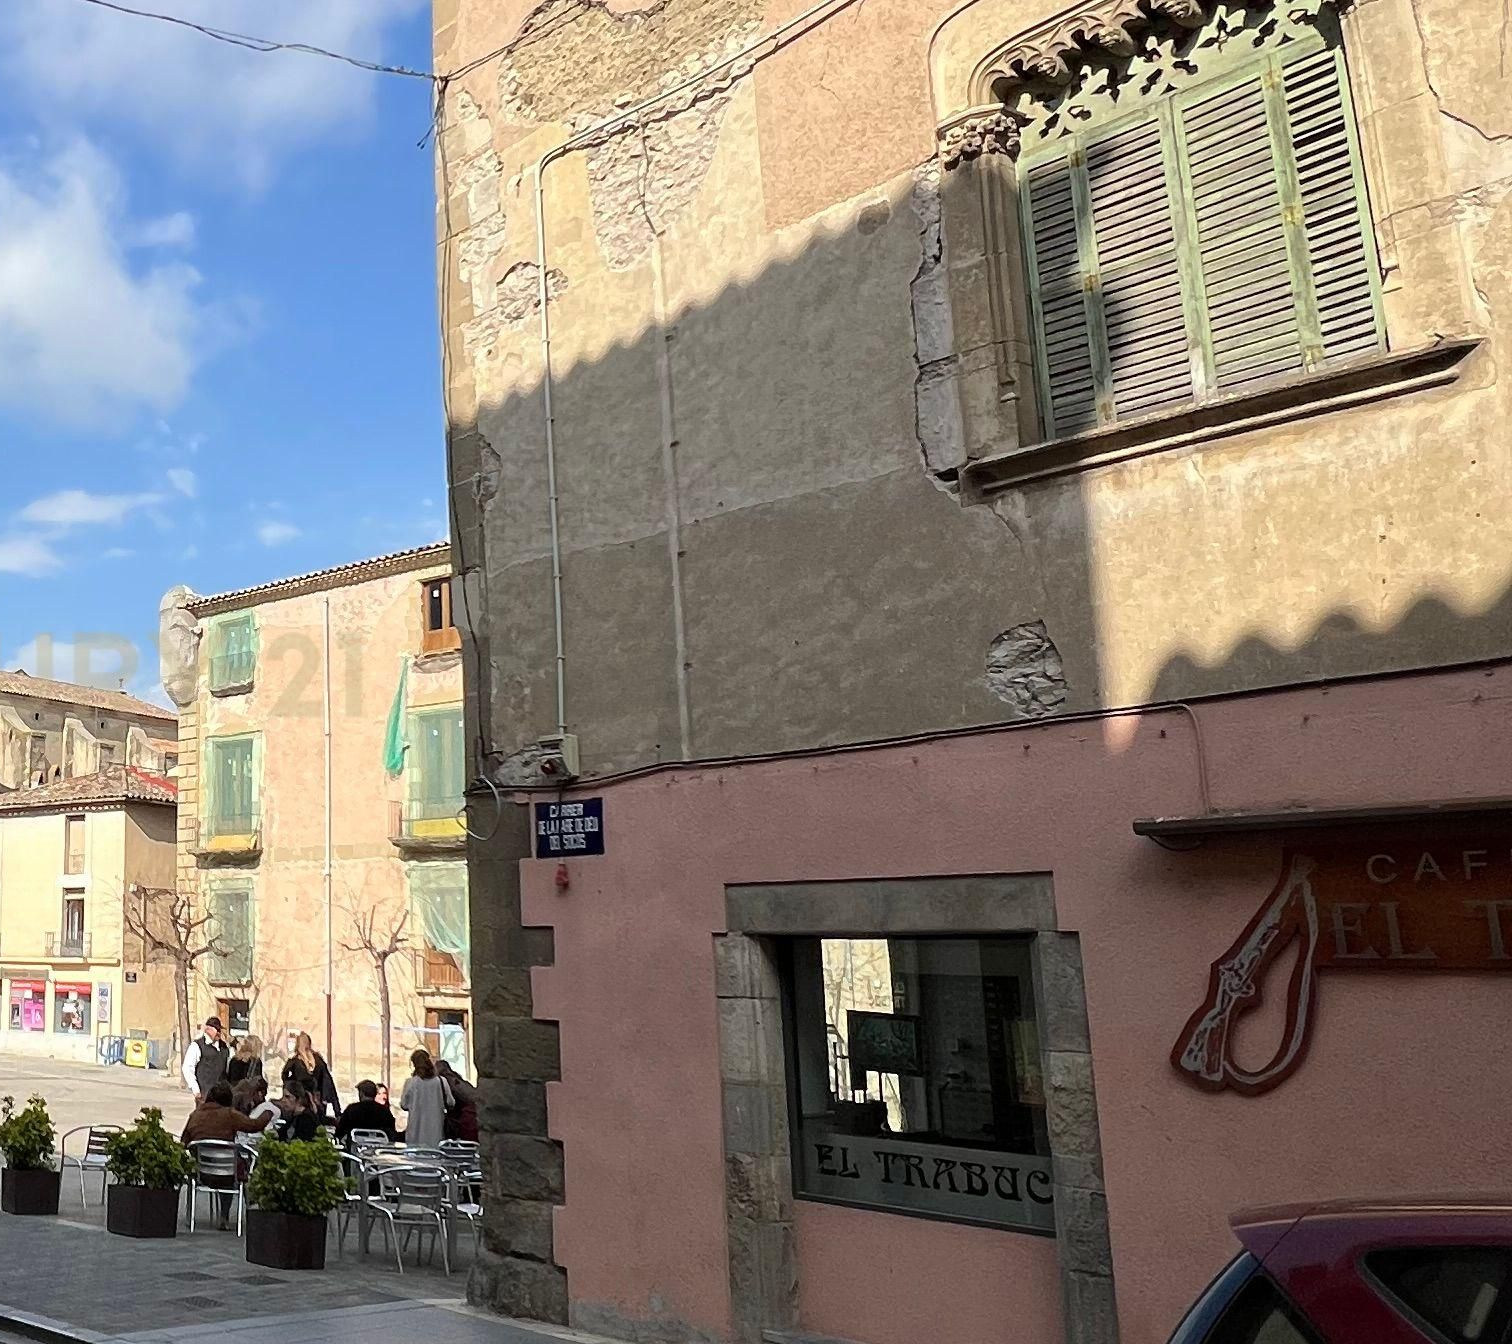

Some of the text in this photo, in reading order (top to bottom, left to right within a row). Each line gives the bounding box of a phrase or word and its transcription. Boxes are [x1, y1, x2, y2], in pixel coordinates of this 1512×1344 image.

[1365, 849, 1512, 884] CAF
[1330, 901, 1438, 960] EL
[814, 1143, 1055, 1205] EL TRABUC
